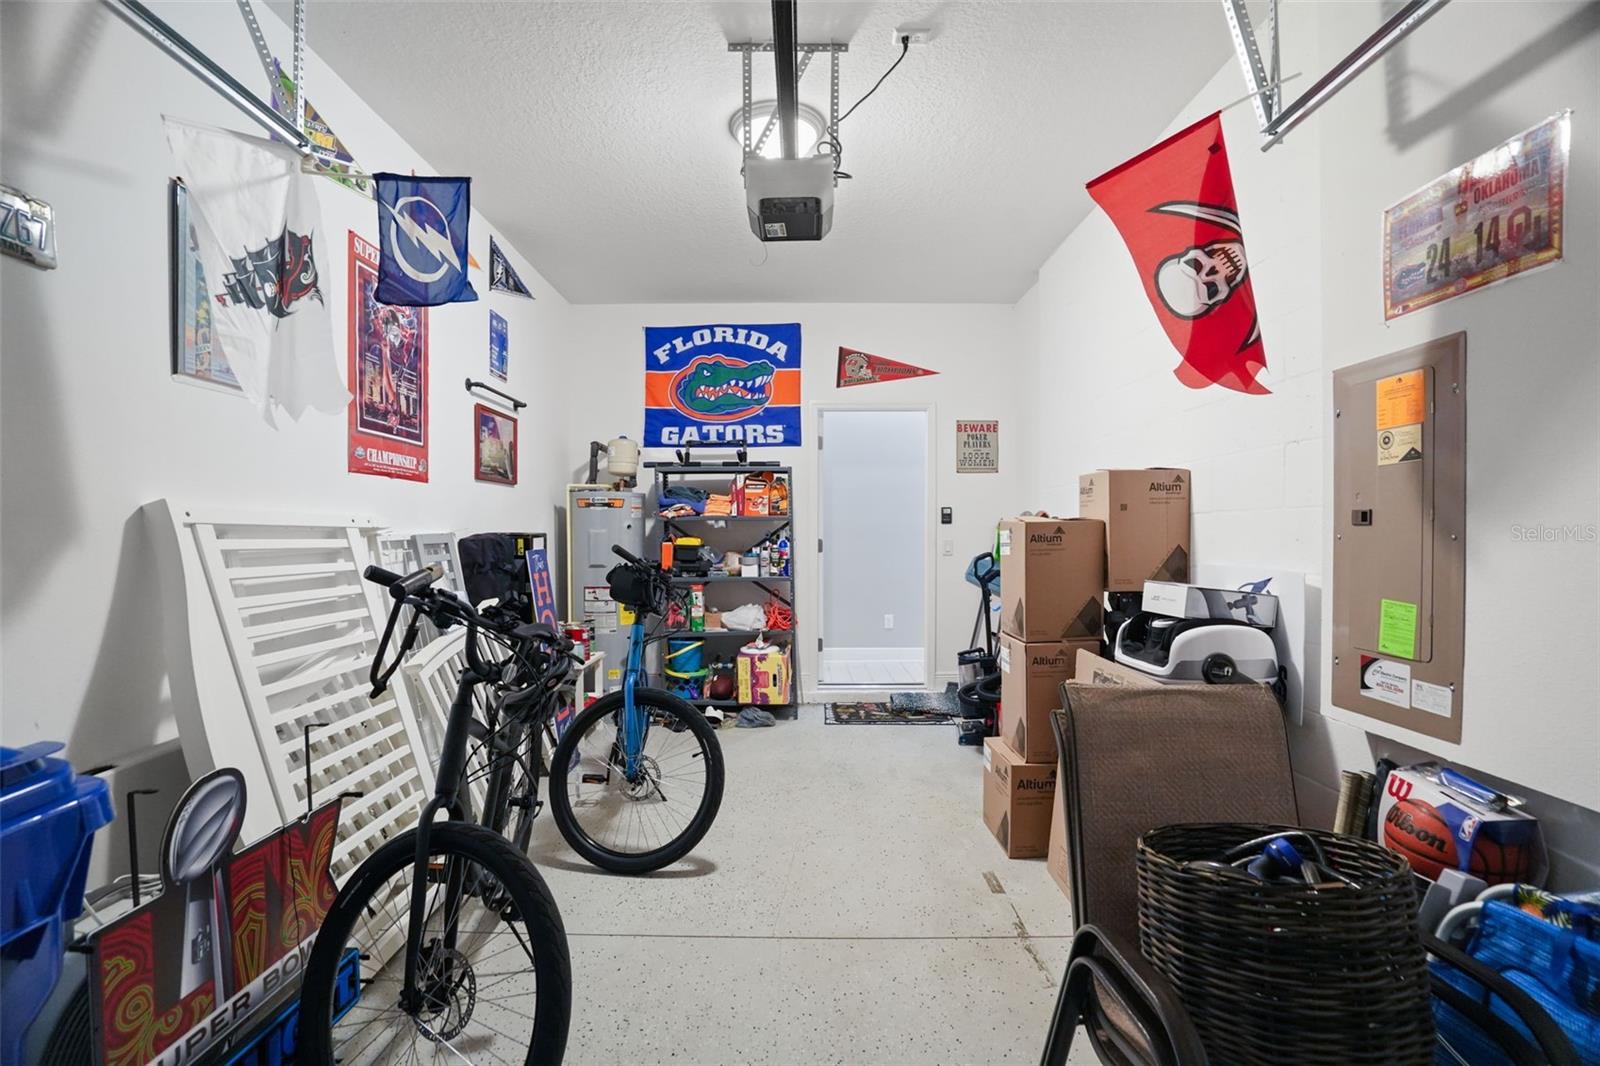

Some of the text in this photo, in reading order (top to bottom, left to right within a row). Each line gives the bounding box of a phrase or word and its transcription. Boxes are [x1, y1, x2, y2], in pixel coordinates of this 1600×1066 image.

[353, 236, 380, 265] SUPE
[1426, 236, 1450, 284] 24
[1474, 215, 1501, 265] 14
[653, 326, 788, 364] FLORIDA
[661, 424, 785, 446] GATORS
[956, 423, 998, 432] BEWARE
[1149, 482, 1182, 492] Altium
[1030, 533, 1063, 543] Altium
[1031, 656, 1065, 666] Altium
[1017, 779, 1057, 790] Altium
[1386, 803, 1448, 853] Wilson
[157, 940, 314, 1066] UPER BOW
